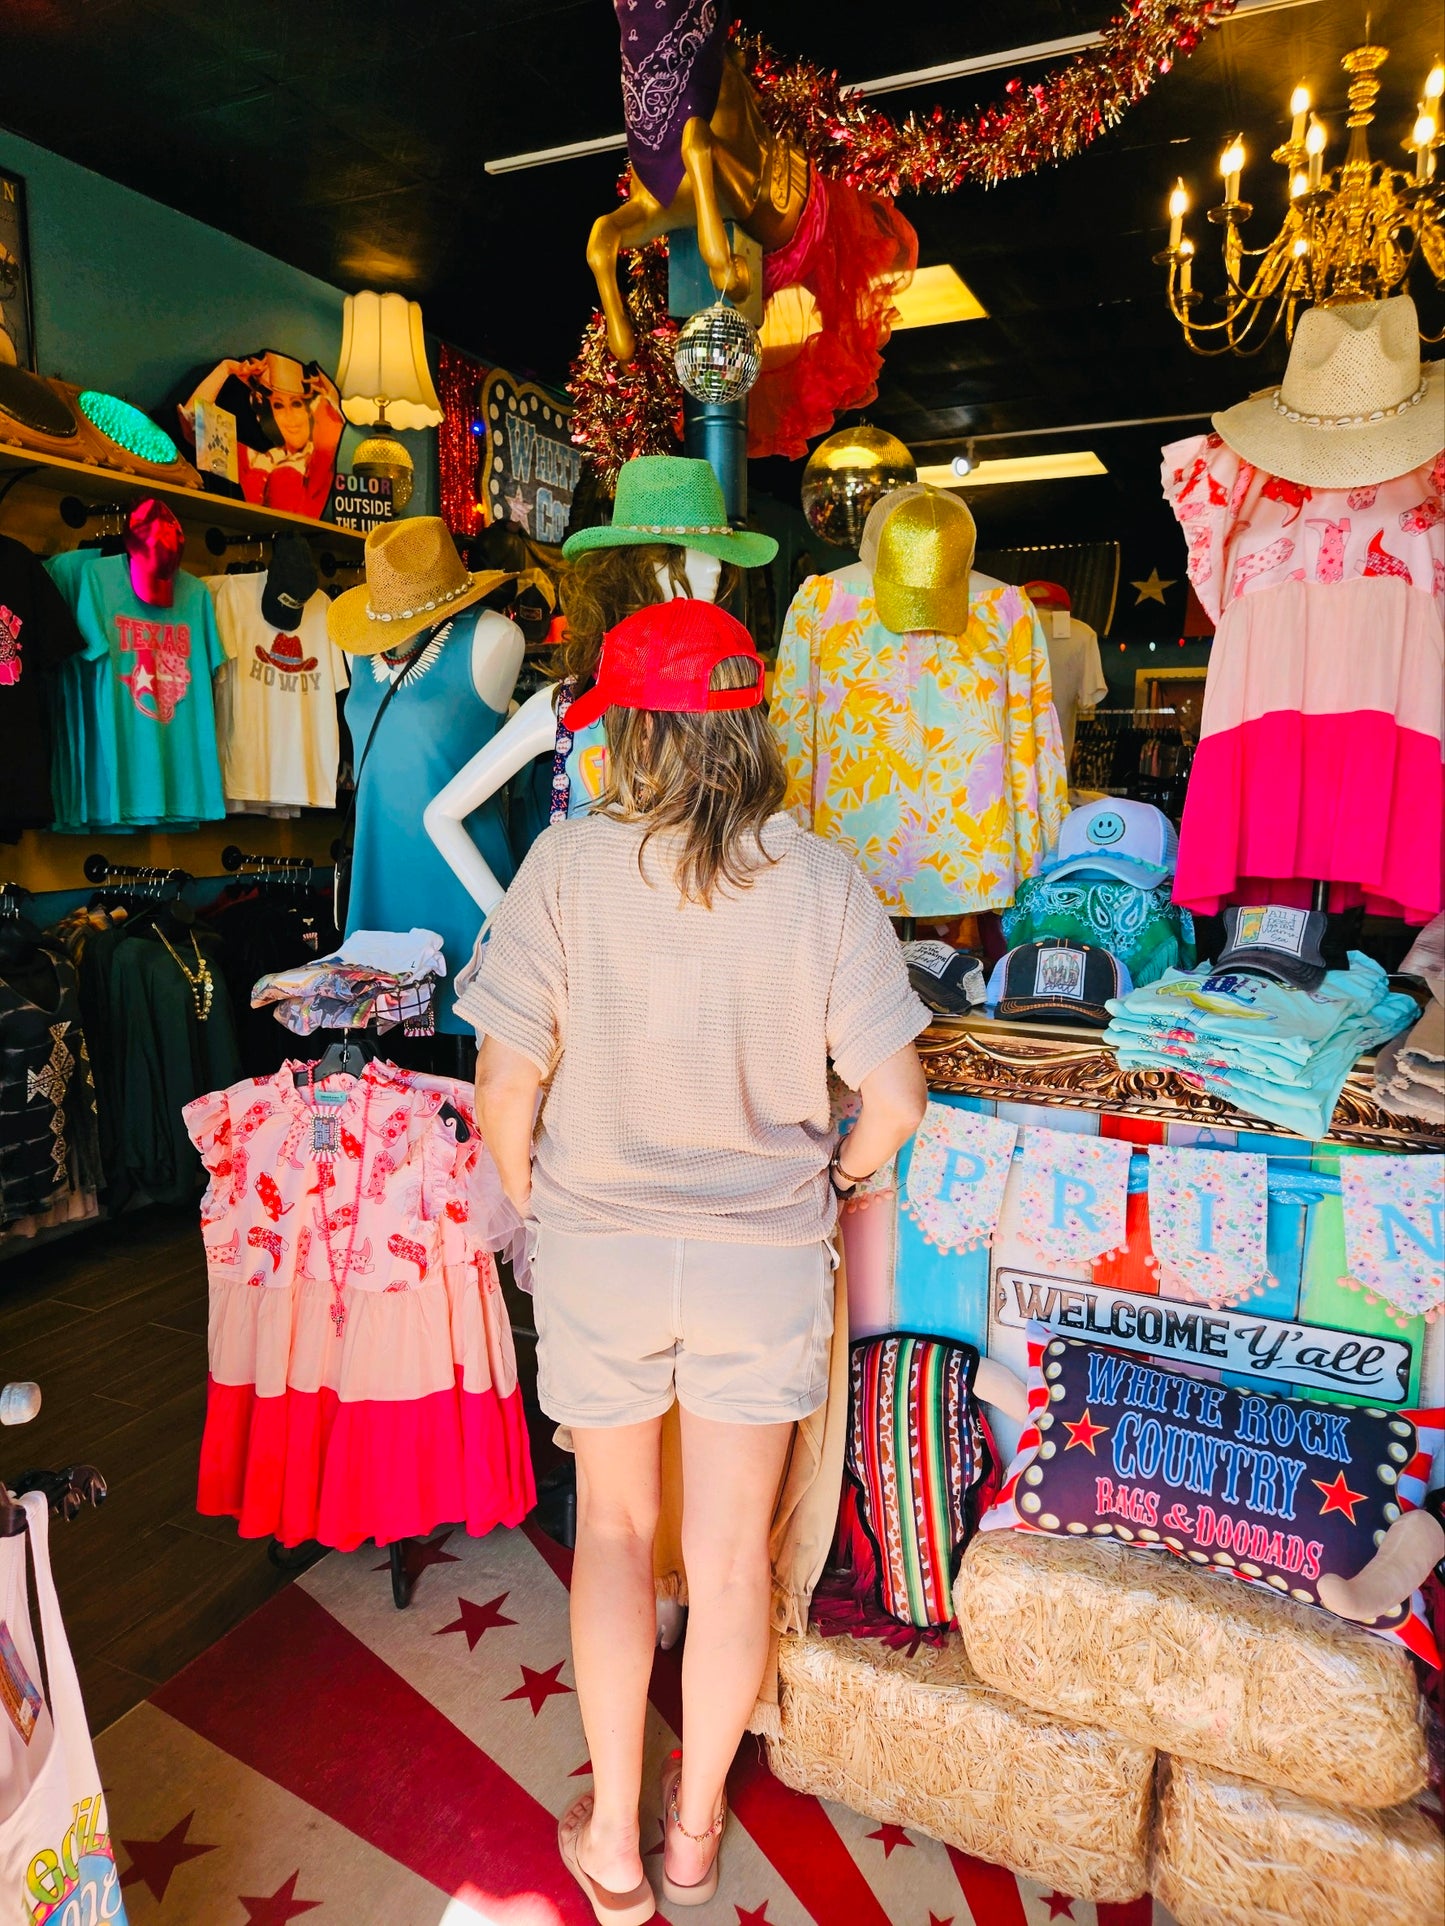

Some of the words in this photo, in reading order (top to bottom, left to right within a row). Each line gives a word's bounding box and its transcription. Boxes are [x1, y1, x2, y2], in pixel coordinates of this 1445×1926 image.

[335, 474, 391, 495] COLOR
[335, 496, 393, 517] OUTSIDE
[336, 517, 357, 530] THE
[114, 615, 191, 658] TEXAS
[249, 659, 321, 693] HOWDY
[1012, 1280, 1230, 1358] WELCOME
[1234, 1325, 1386, 1378] Y'all
[1086, 1352, 1227, 1429] WHITE
[1235, 1395, 1352, 1463] ROCK
[1111, 1411, 1306, 1521] COUNTRY
[1095, 1476, 1160, 1527] RAGS
[1163, 1503, 1195, 1534] &
[1193, 1504, 1324, 1580] DOODADS
